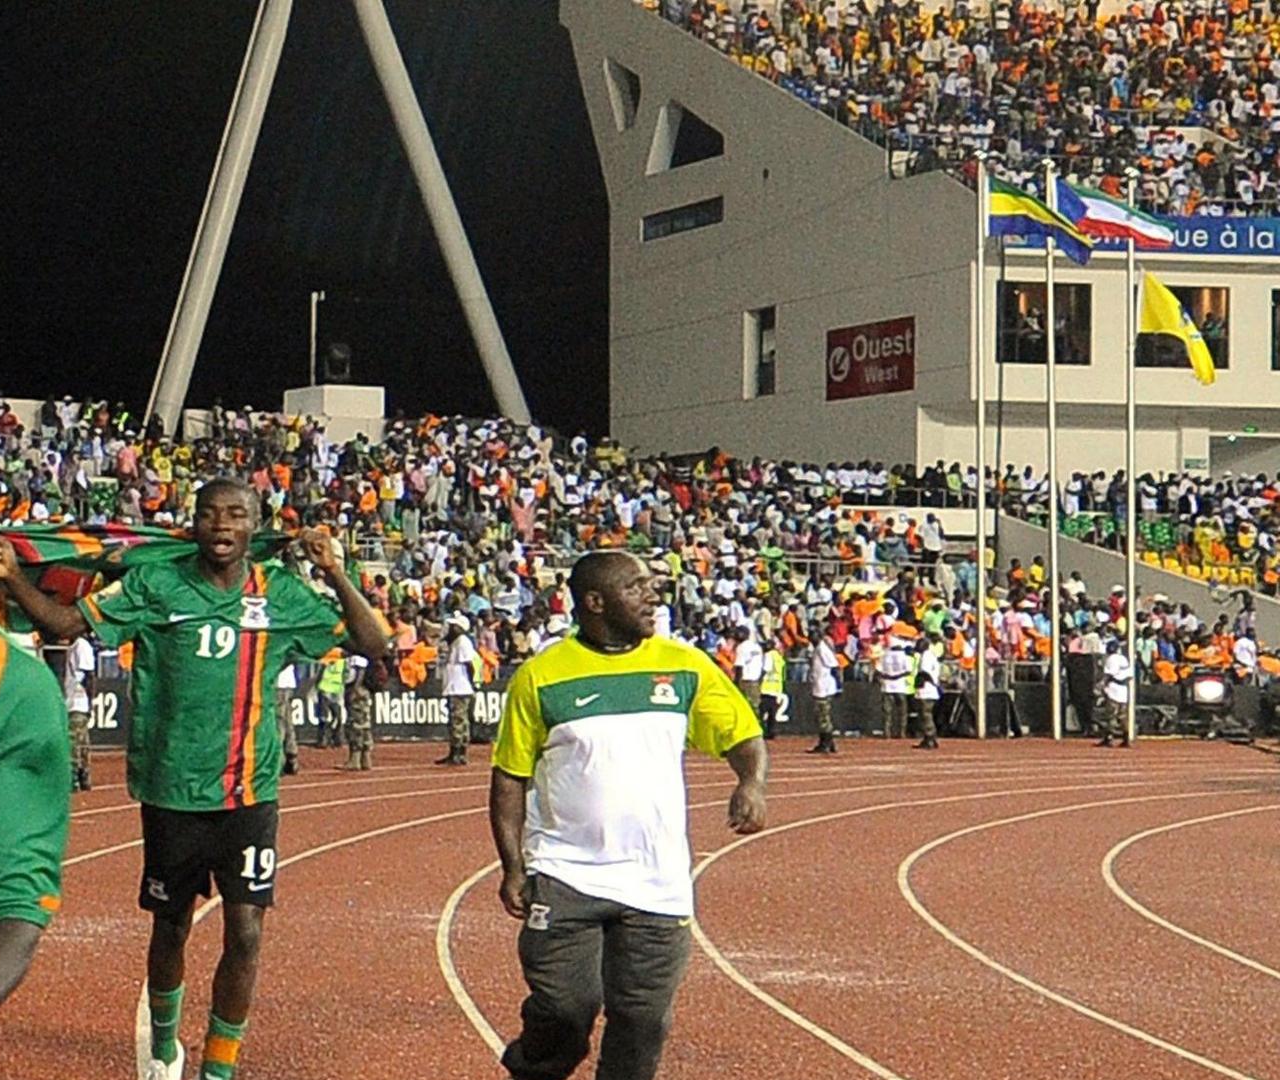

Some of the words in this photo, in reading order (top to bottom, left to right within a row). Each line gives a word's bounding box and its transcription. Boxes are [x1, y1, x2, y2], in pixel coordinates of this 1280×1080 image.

[1248, 224, 1275, 250] la
[852, 327, 914, 362] Ouest
[863, 364, 899, 384] West
[195, 623, 237, 659] 19
[374, 691, 450, 725] Nations
[239, 845, 276, 881] 19
